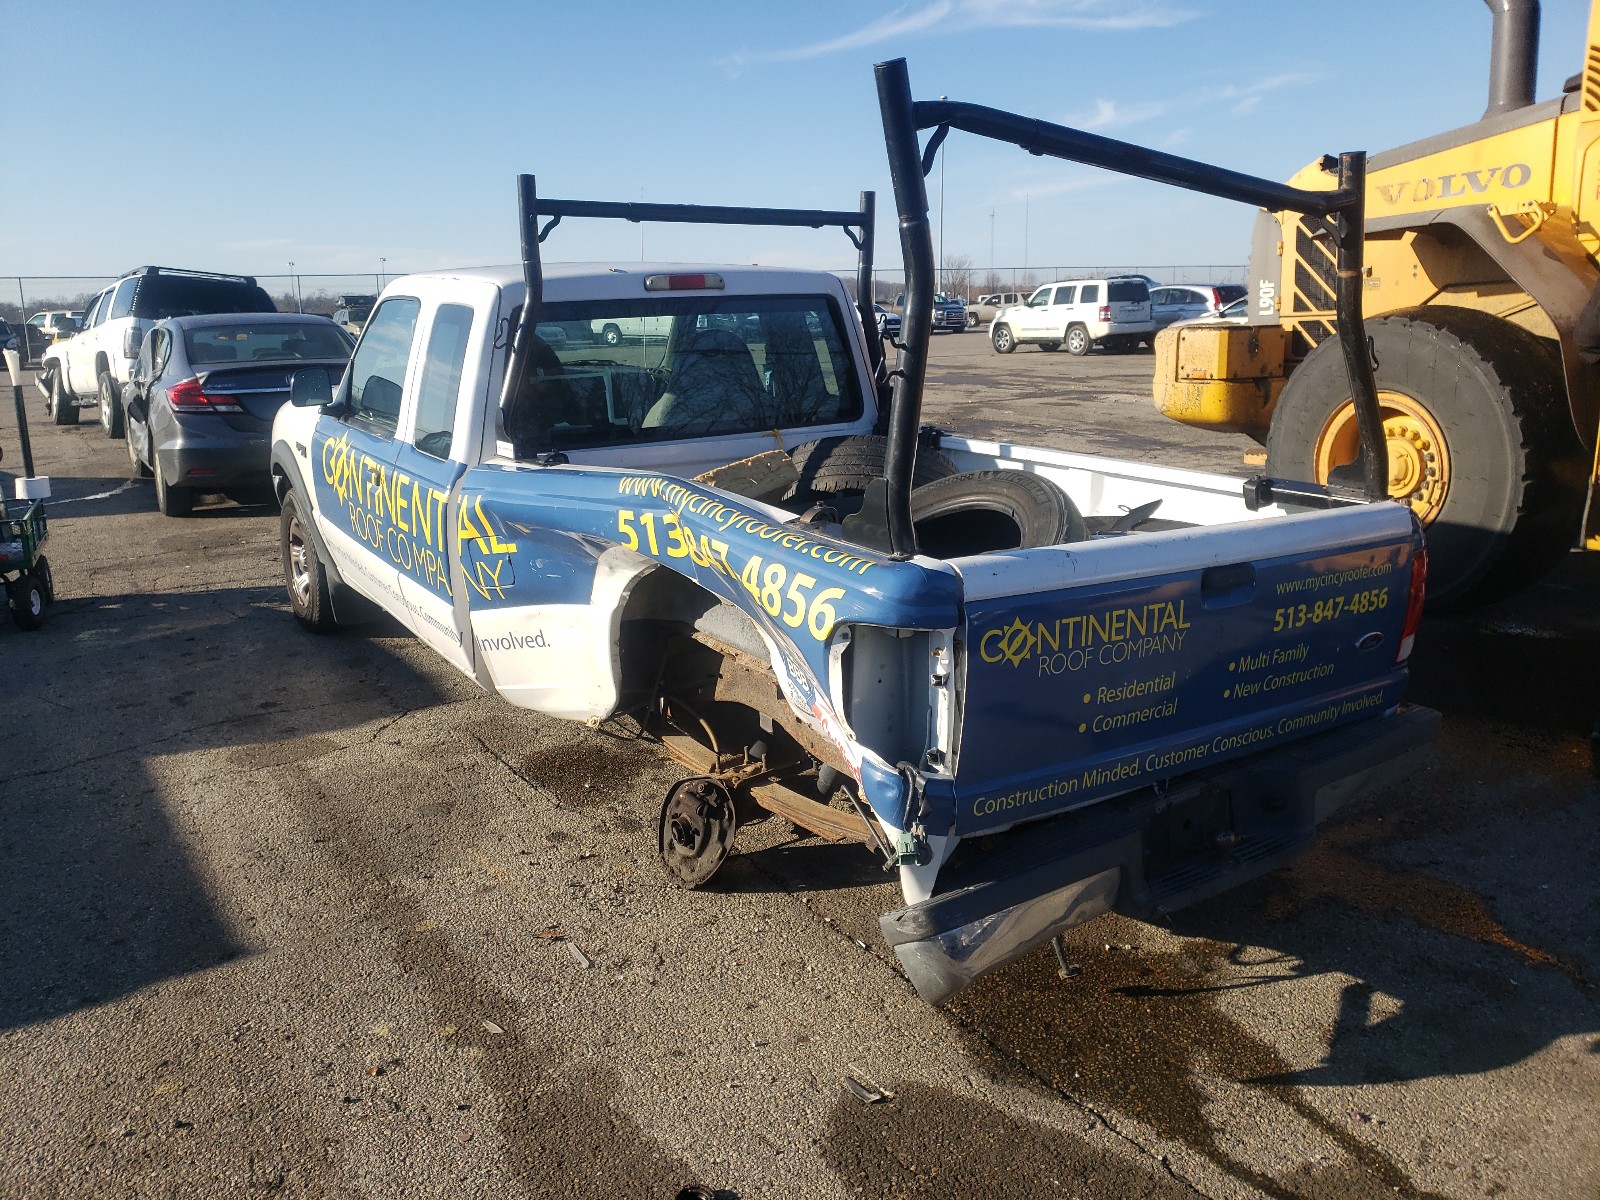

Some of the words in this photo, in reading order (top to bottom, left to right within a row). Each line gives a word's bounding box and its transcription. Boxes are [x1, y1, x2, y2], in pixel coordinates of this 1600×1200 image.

[1376, 163, 1532, 205] VOLVO
[1258, 279, 1275, 316] L90F
[322, 430, 518, 556] CONTINENTAL
[349, 501, 384, 552] ROOF
[386, 527, 506, 602] COMPANY
[616, 509, 847, 642] 513847-4856
[1276, 563, 1392, 596] www.mycincyroofer.com
[1273, 587, 1389, 633] 513-847-4856
[979, 599, 1191, 668] CONTINENTAL
[1037, 647, 1095, 678] ROOF
[1099, 630, 1187, 666] COMPANY
[1233, 680, 1261, 699] New
[1263, 662, 1335, 691] Construction
[1238, 655, 1270, 674] Multi
[1272, 643, 1310, 667] Family
[1096, 670, 1176, 705] Residential
[1092, 697, 1178, 733] Commercial
[973, 776, 1078, 817] Construction
[1082, 758, 1142, 786] Minded.
[1145, 743, 1210, 773] Customer
[1212, 725, 1275, 753] Conscious.
[1278, 705, 1340, 735] Community
[1341, 690, 1384, 715] Involved.
